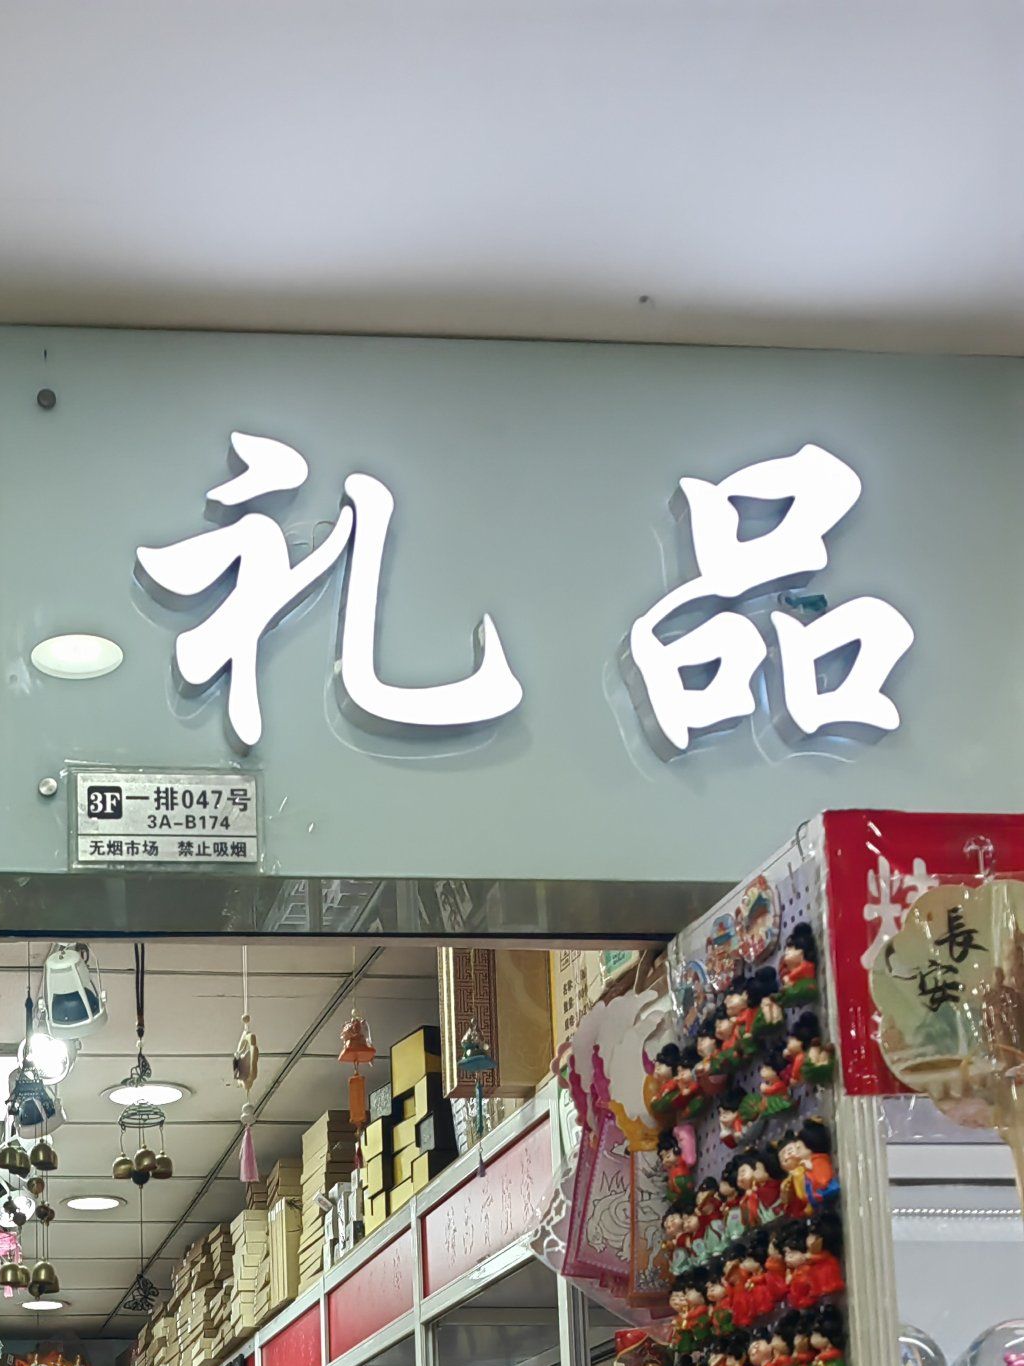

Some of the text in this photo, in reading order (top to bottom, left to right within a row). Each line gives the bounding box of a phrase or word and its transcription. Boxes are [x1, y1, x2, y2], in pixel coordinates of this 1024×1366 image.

[89, 786, 252, 814] 3F 一排047号
[147, 814, 231, 830] 3A-B174
[89, 840, 248, 858] 无烟市场 禁止吸烟
